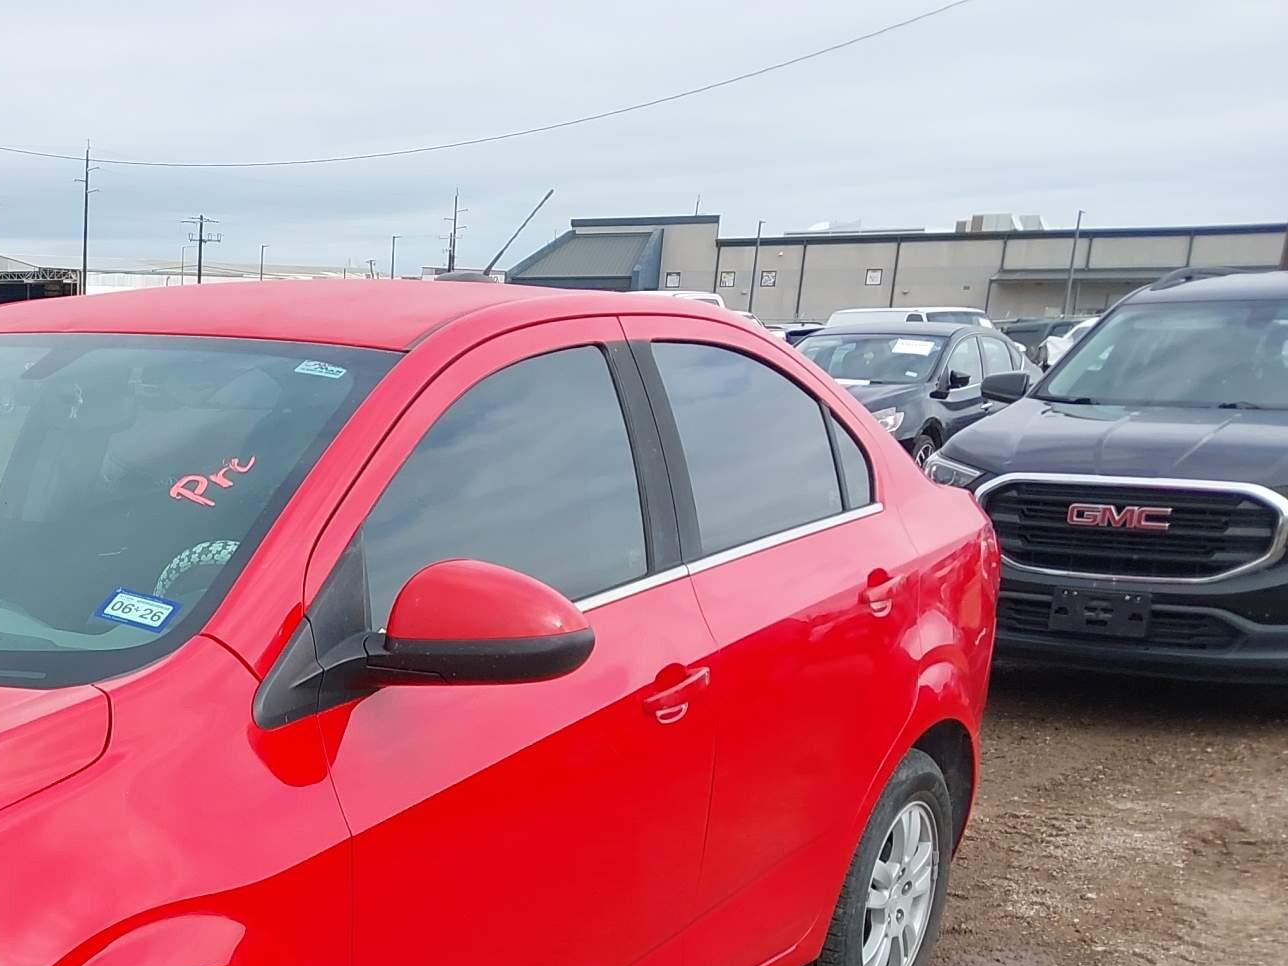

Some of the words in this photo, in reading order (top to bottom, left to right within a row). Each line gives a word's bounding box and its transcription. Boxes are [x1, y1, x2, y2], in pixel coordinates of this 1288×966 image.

[1067, 503, 1172, 530] GMC
[111, 600, 135, 614] 06
[139, 608, 164, 622] 26
